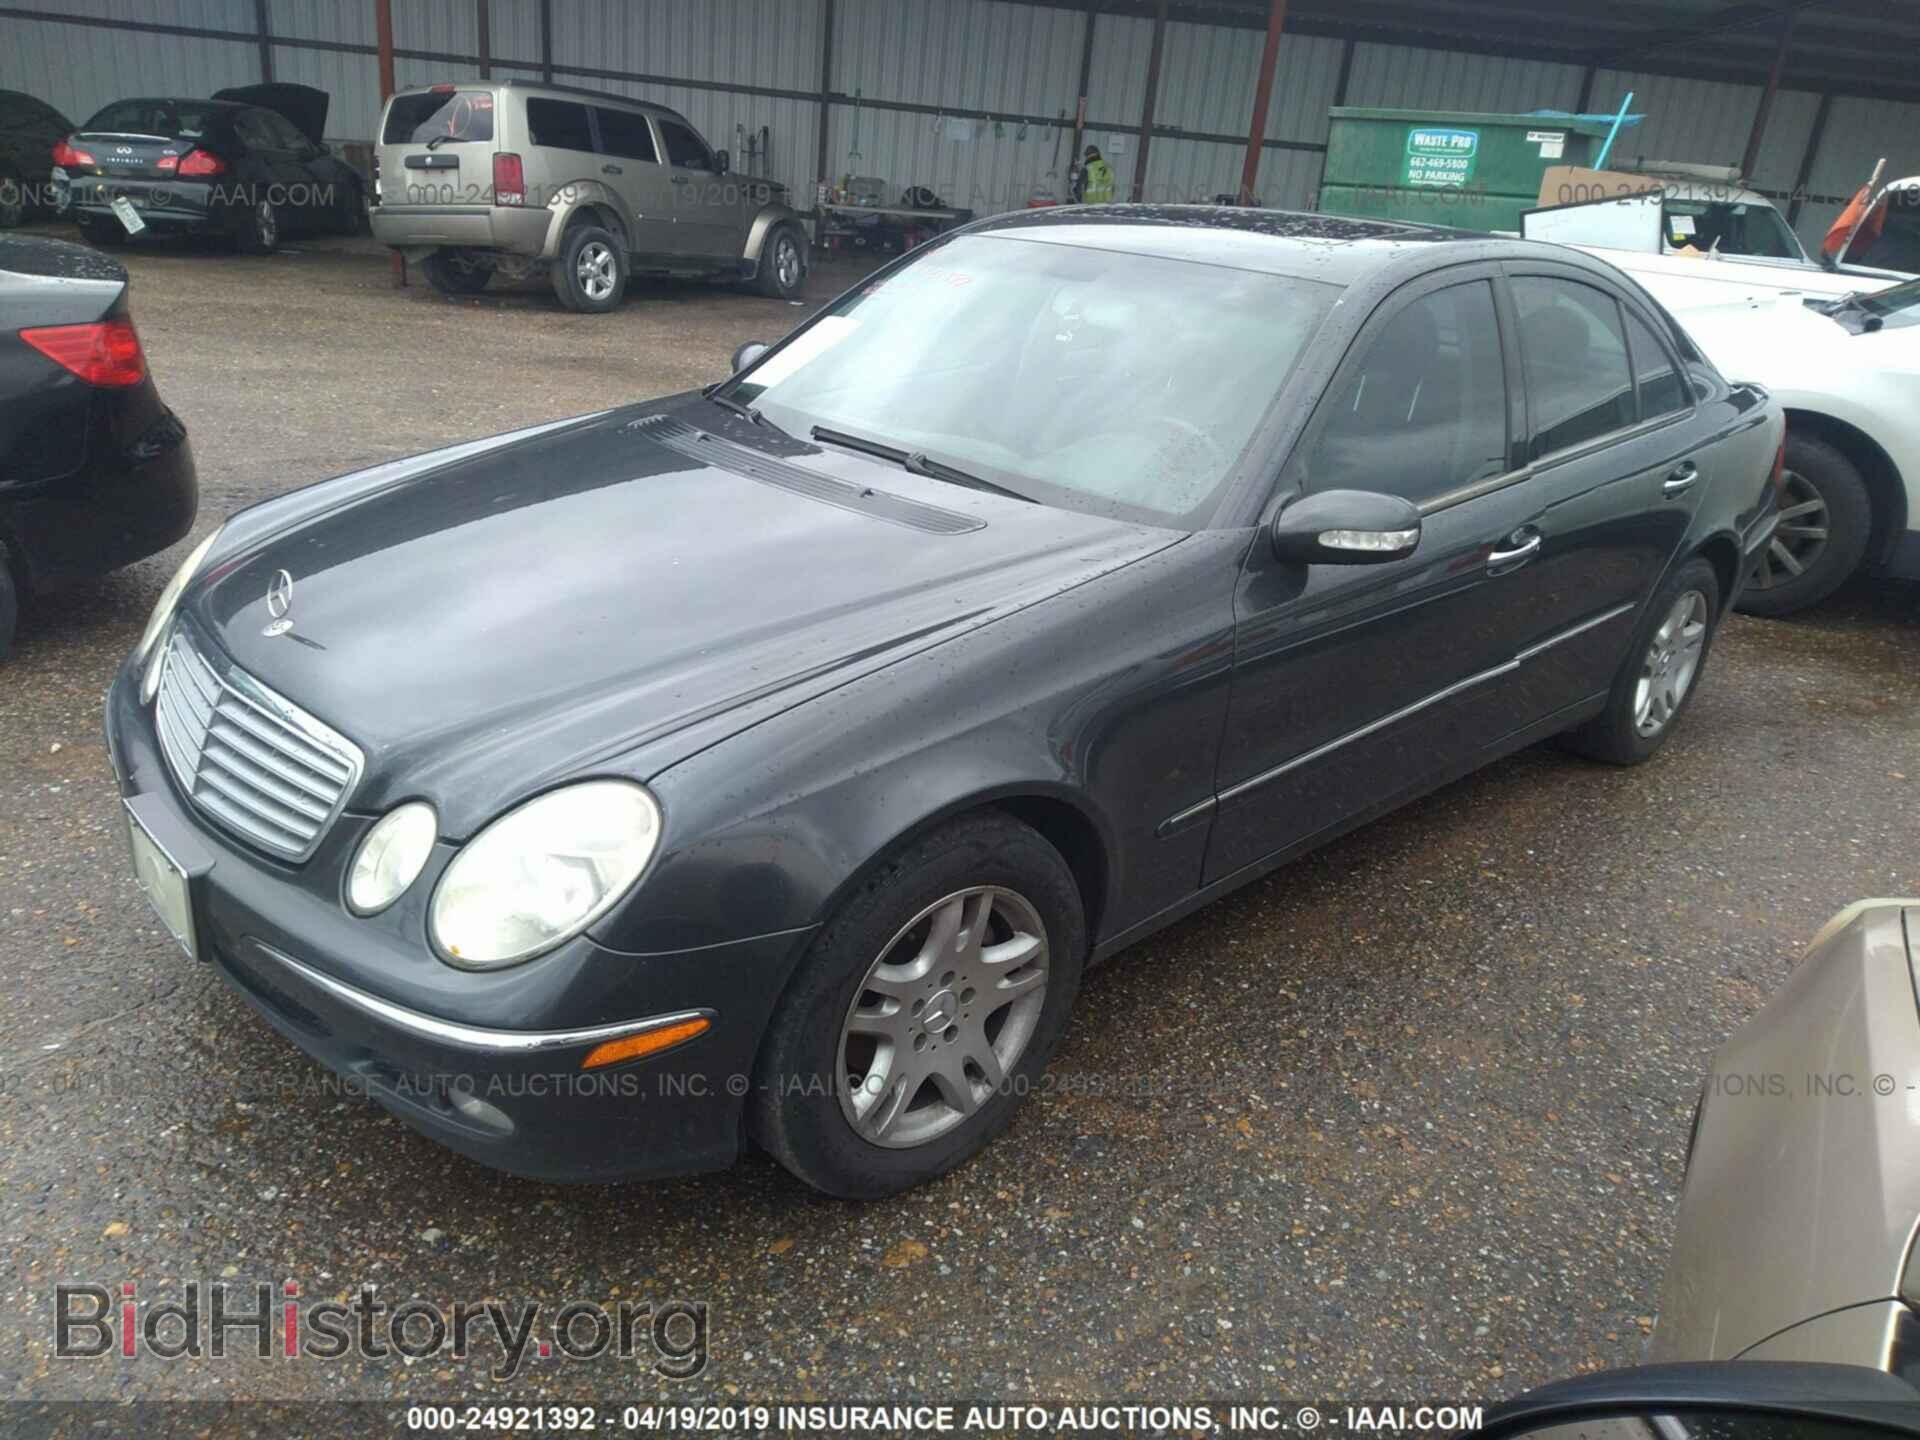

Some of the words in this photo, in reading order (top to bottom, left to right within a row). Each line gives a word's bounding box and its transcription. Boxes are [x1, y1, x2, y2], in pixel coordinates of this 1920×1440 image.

[1414, 133, 1448, 147] WASTE
[1451, 135, 1472, 148] PRO
[1408, 170, 1422, 180] NO
[1424, 171, 1465, 182] PARKING
